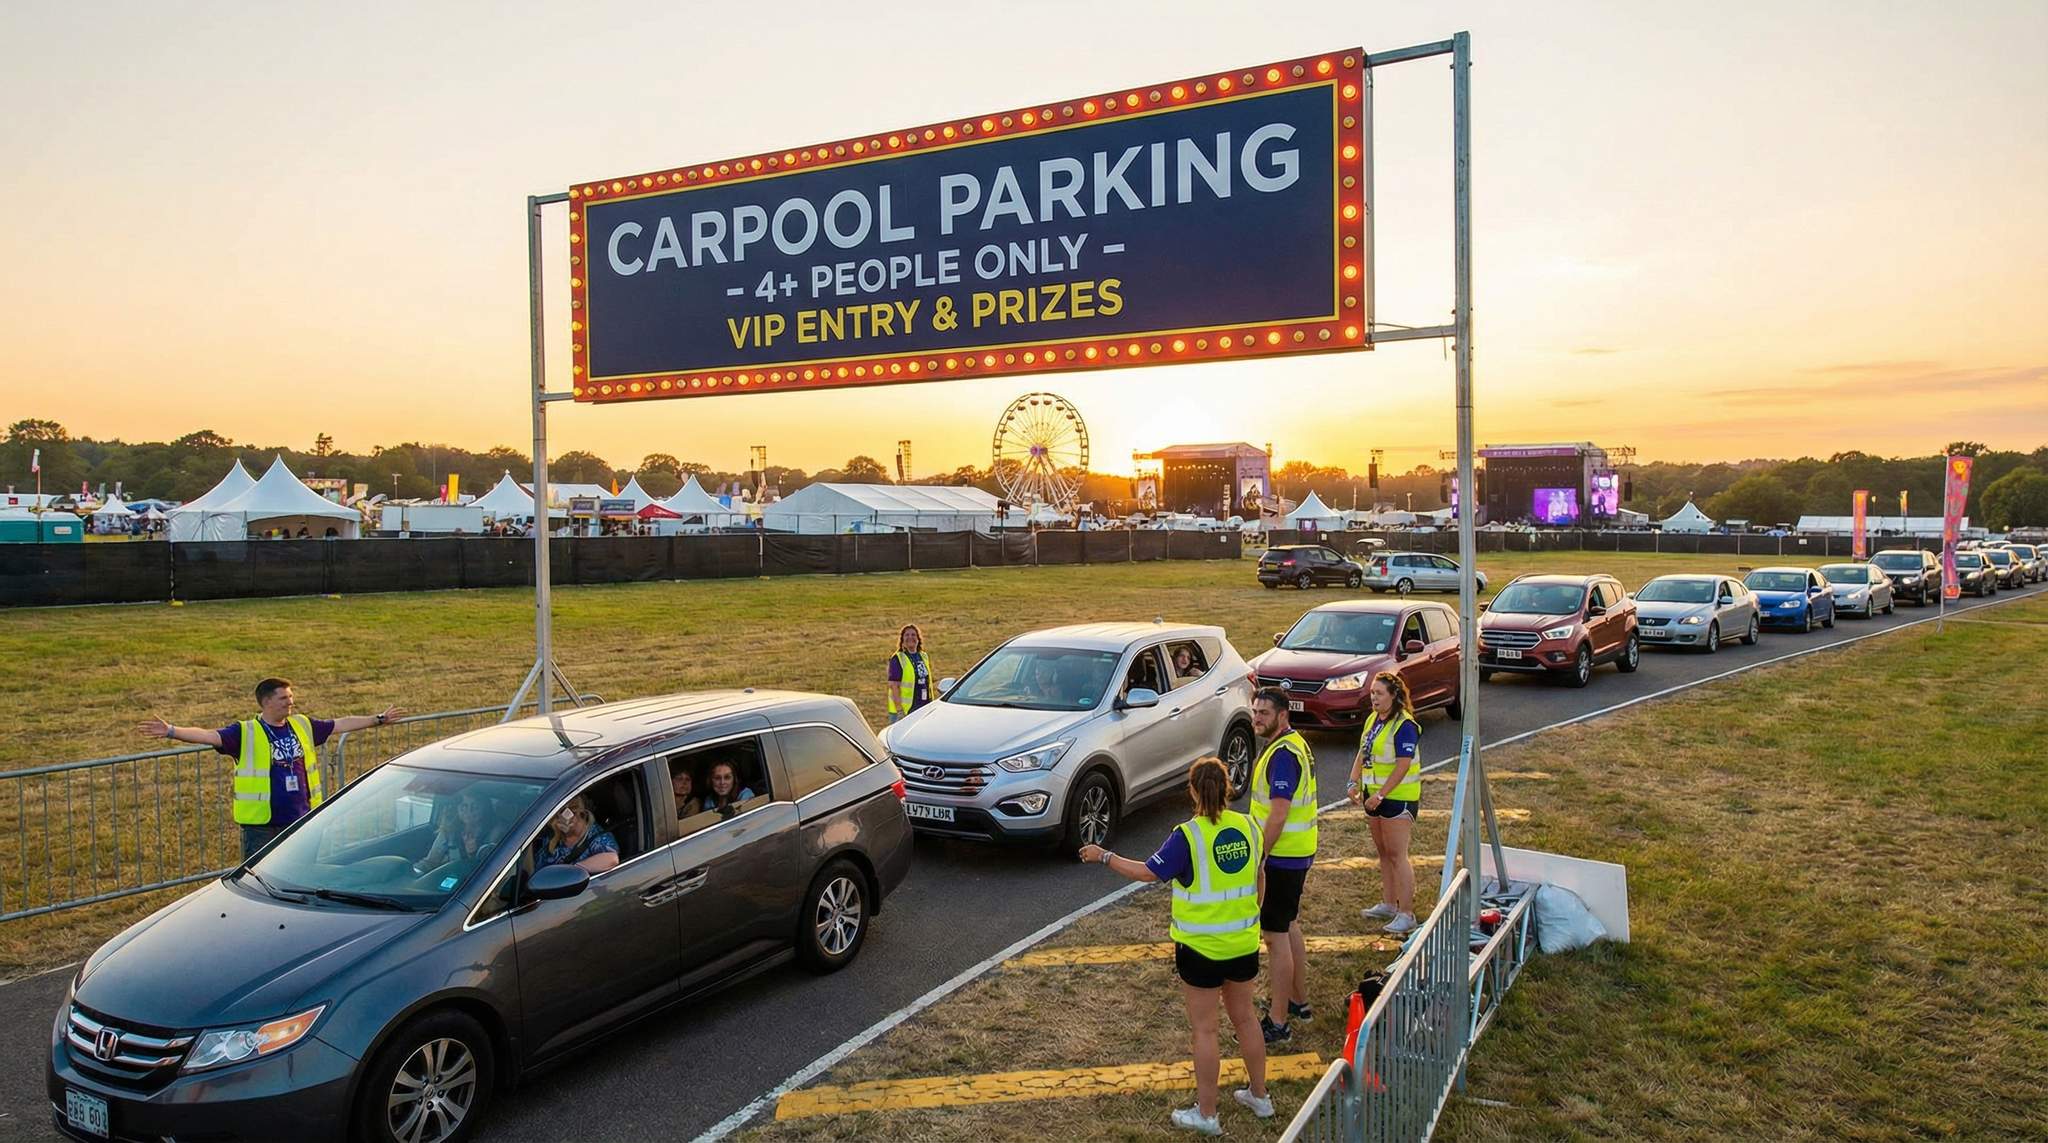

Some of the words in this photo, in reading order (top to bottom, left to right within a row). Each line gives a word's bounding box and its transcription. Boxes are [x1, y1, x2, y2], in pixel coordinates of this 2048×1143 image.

[607, 184, 916, 276] CARPOOL
[940, 122, 1301, 235] PARKING
[755, 271, 798, 303] 4+
[811, 248, 961, 298] PEOPLE
[974, 233, 1090, 280] ONLY
[727, 314, 783, 350] VIP
[797, 300, 919, 345] ENTRY
[932, 295, 958, 331] &
[972, 277, 1124, 328] PRIZES
